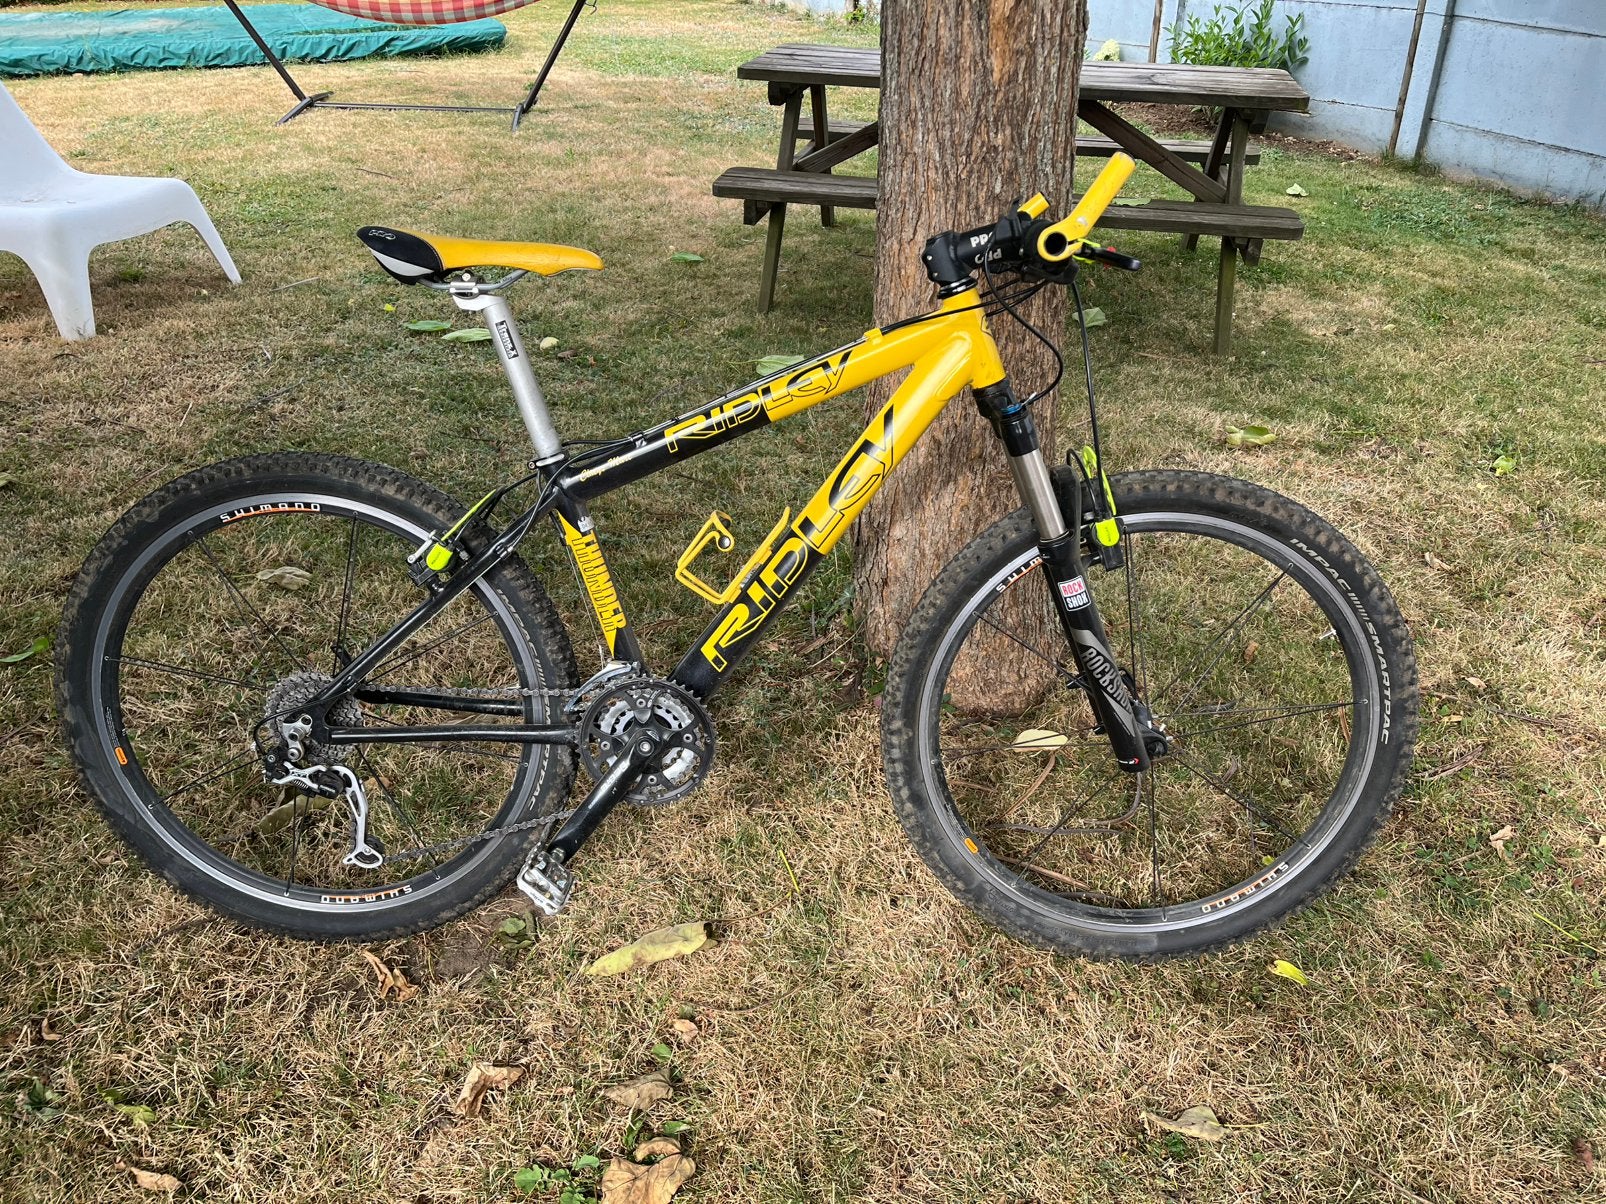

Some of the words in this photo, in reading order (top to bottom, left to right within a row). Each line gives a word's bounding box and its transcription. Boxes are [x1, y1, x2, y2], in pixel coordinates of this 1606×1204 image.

[970, 231, 993, 247] PR
[664, 349, 854, 453] RIDLEY
[219, 502, 321, 523] SHIMANO
[700, 403, 896, 673] RIDLEY
[571, 530, 627, 633] THUNDER
[995, 556, 1043, 594] SHIM
[1061, 579, 1085, 595] ROCK
[1066, 594, 1089, 609] SHOX
[1289, 538, 1352, 592] IMPAC
[1364, 620, 1393, 746] SMARTPAC
[528, 695, 552, 812] SMRTPAC
